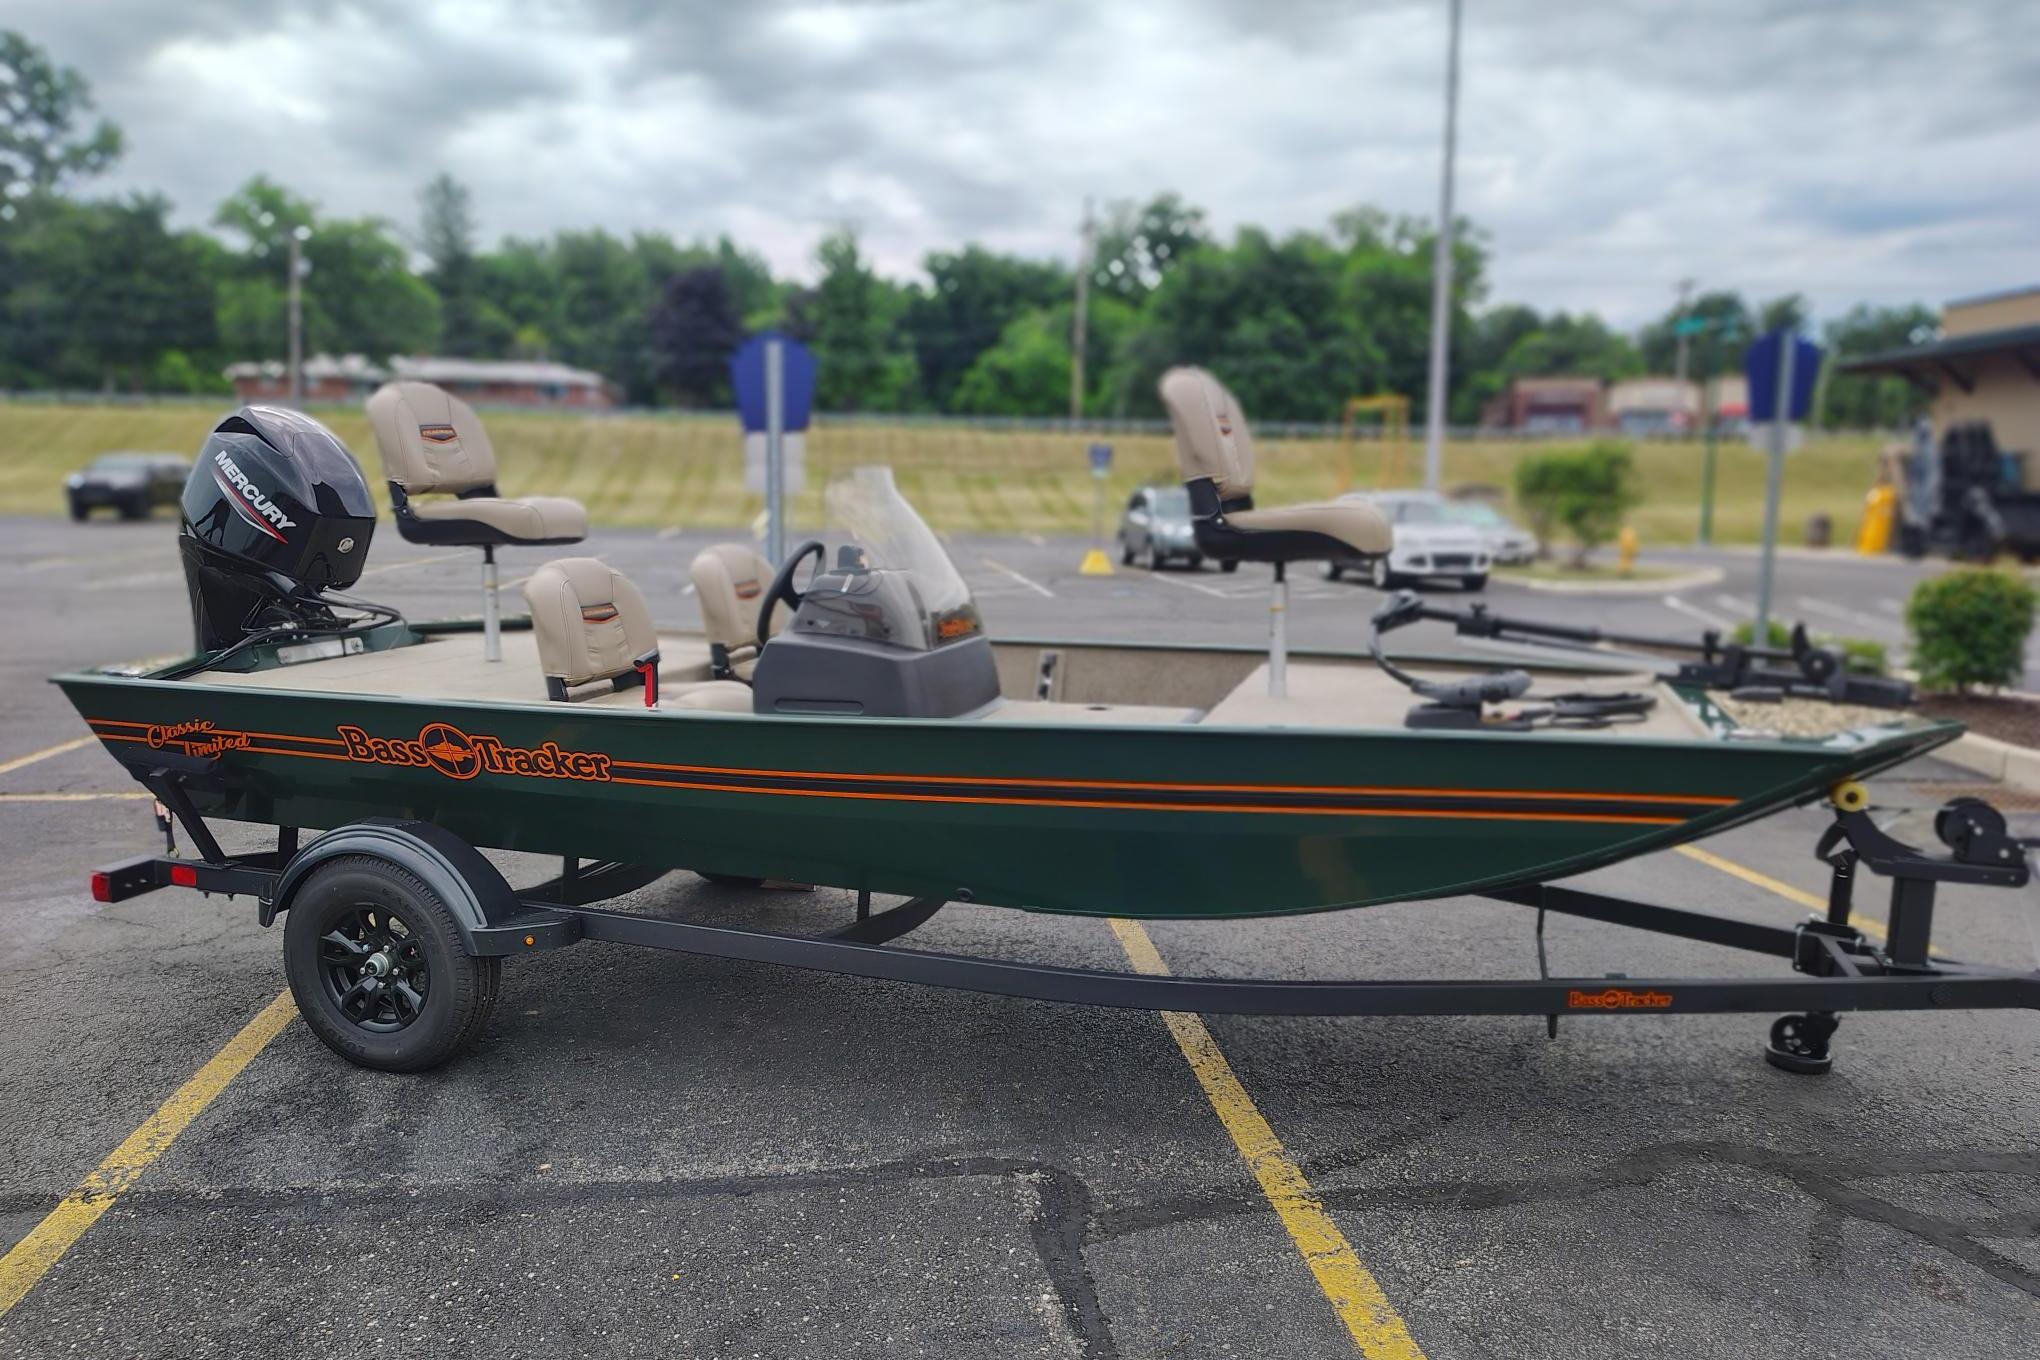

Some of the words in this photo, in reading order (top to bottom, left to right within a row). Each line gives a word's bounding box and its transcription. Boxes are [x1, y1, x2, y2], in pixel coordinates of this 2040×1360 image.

[215, 450, 296, 529] MERCURY
[147, 719, 215, 748] Classic
[338, 726, 429, 766] Bass
[470, 735, 612, 782] Tracker
[1569, 991, 1605, 1008] Bass
[1620, 991, 1673, 1008] Tracker
